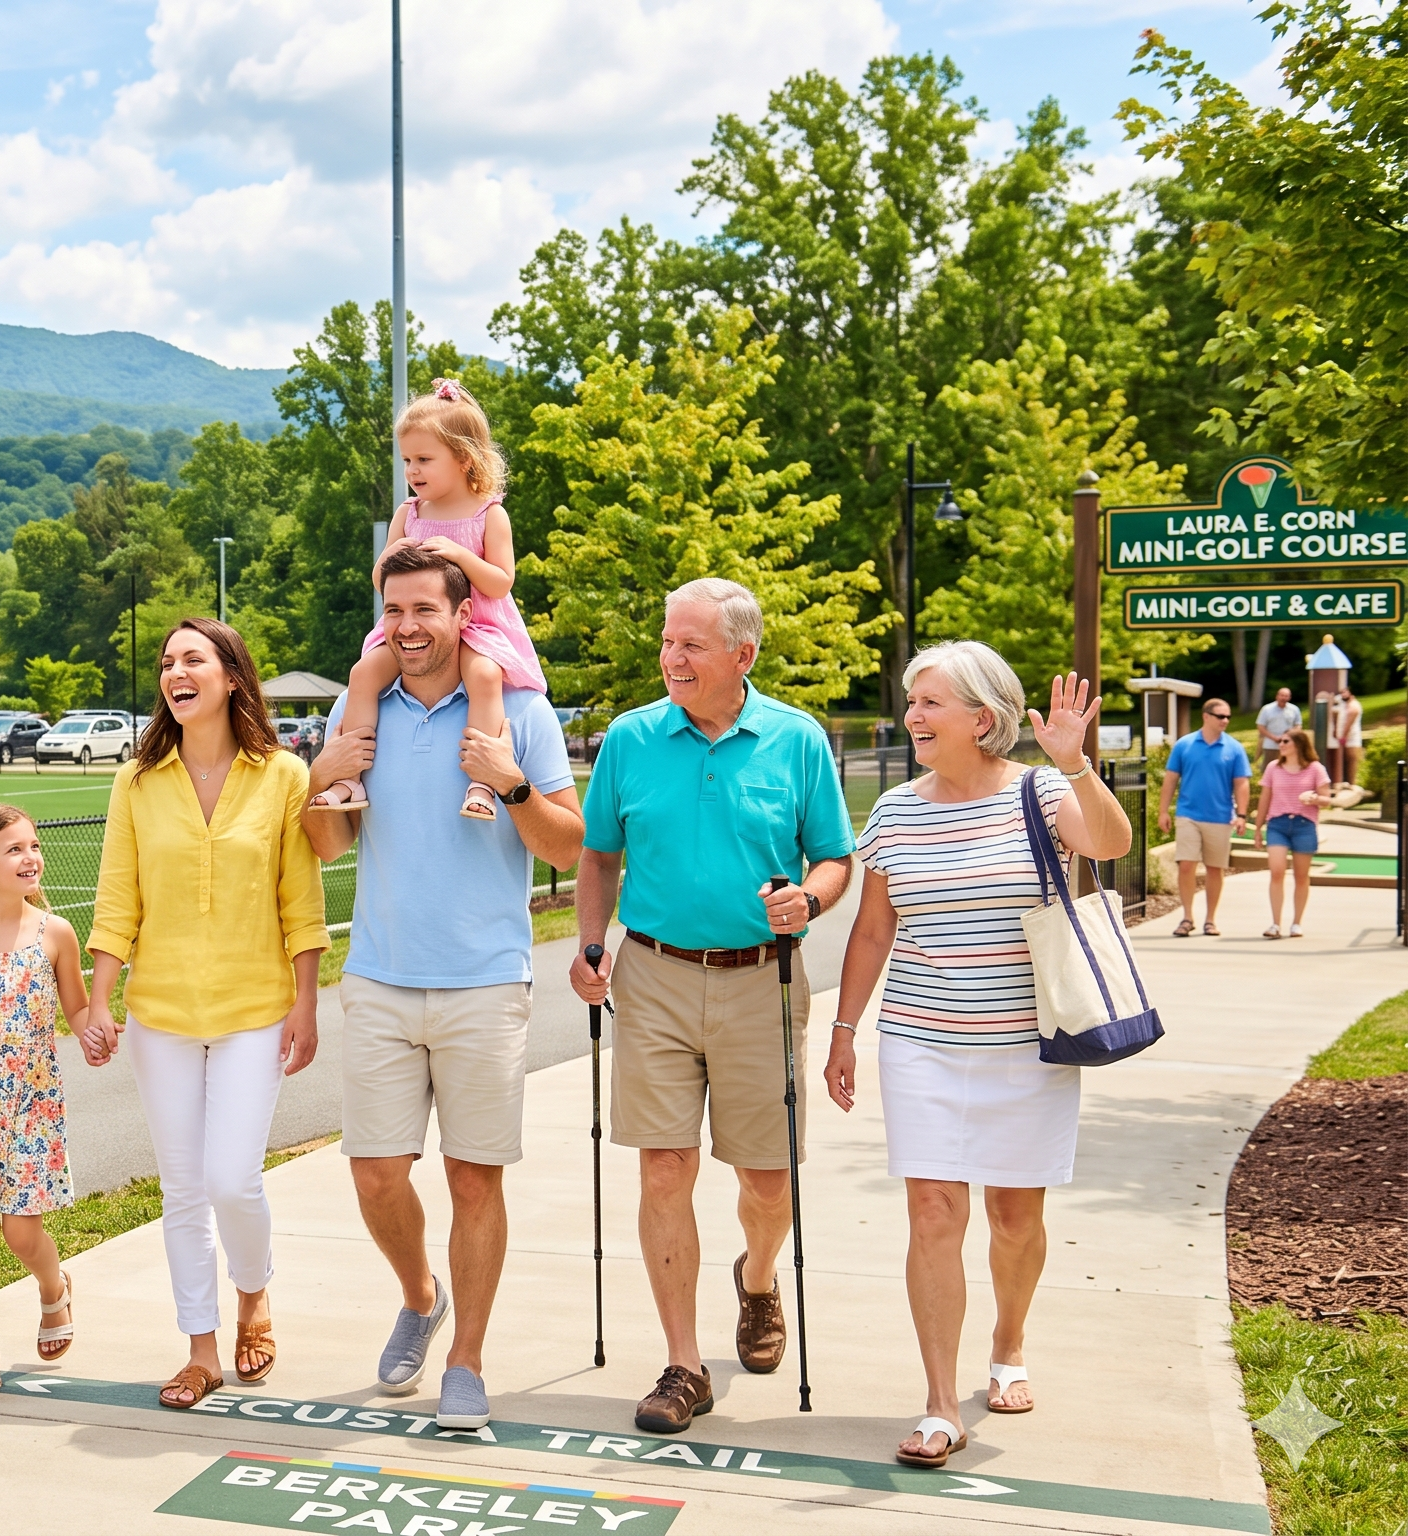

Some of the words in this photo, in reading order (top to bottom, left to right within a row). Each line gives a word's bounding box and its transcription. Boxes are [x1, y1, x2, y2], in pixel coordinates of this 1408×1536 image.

[1166, 514, 1249, 536] LAURA
[1253, 512, 1277, 533] E.
[1280, 509, 1356, 532] CORN
[1118, 536, 1275, 564] MINI-GOLF
[1280, 532, 1408, 559] COURSE
[1135, 595, 1282, 620] MINI-GOLF
[1287, 594, 1309, 617] &
[1313, 592, 1389, 616] CAFE
[189, 1395, 498, 1444] ECUSTA
[539, 1428, 782, 1475] TRAIL
[220, 1464, 650, 1532] BERKELEY
